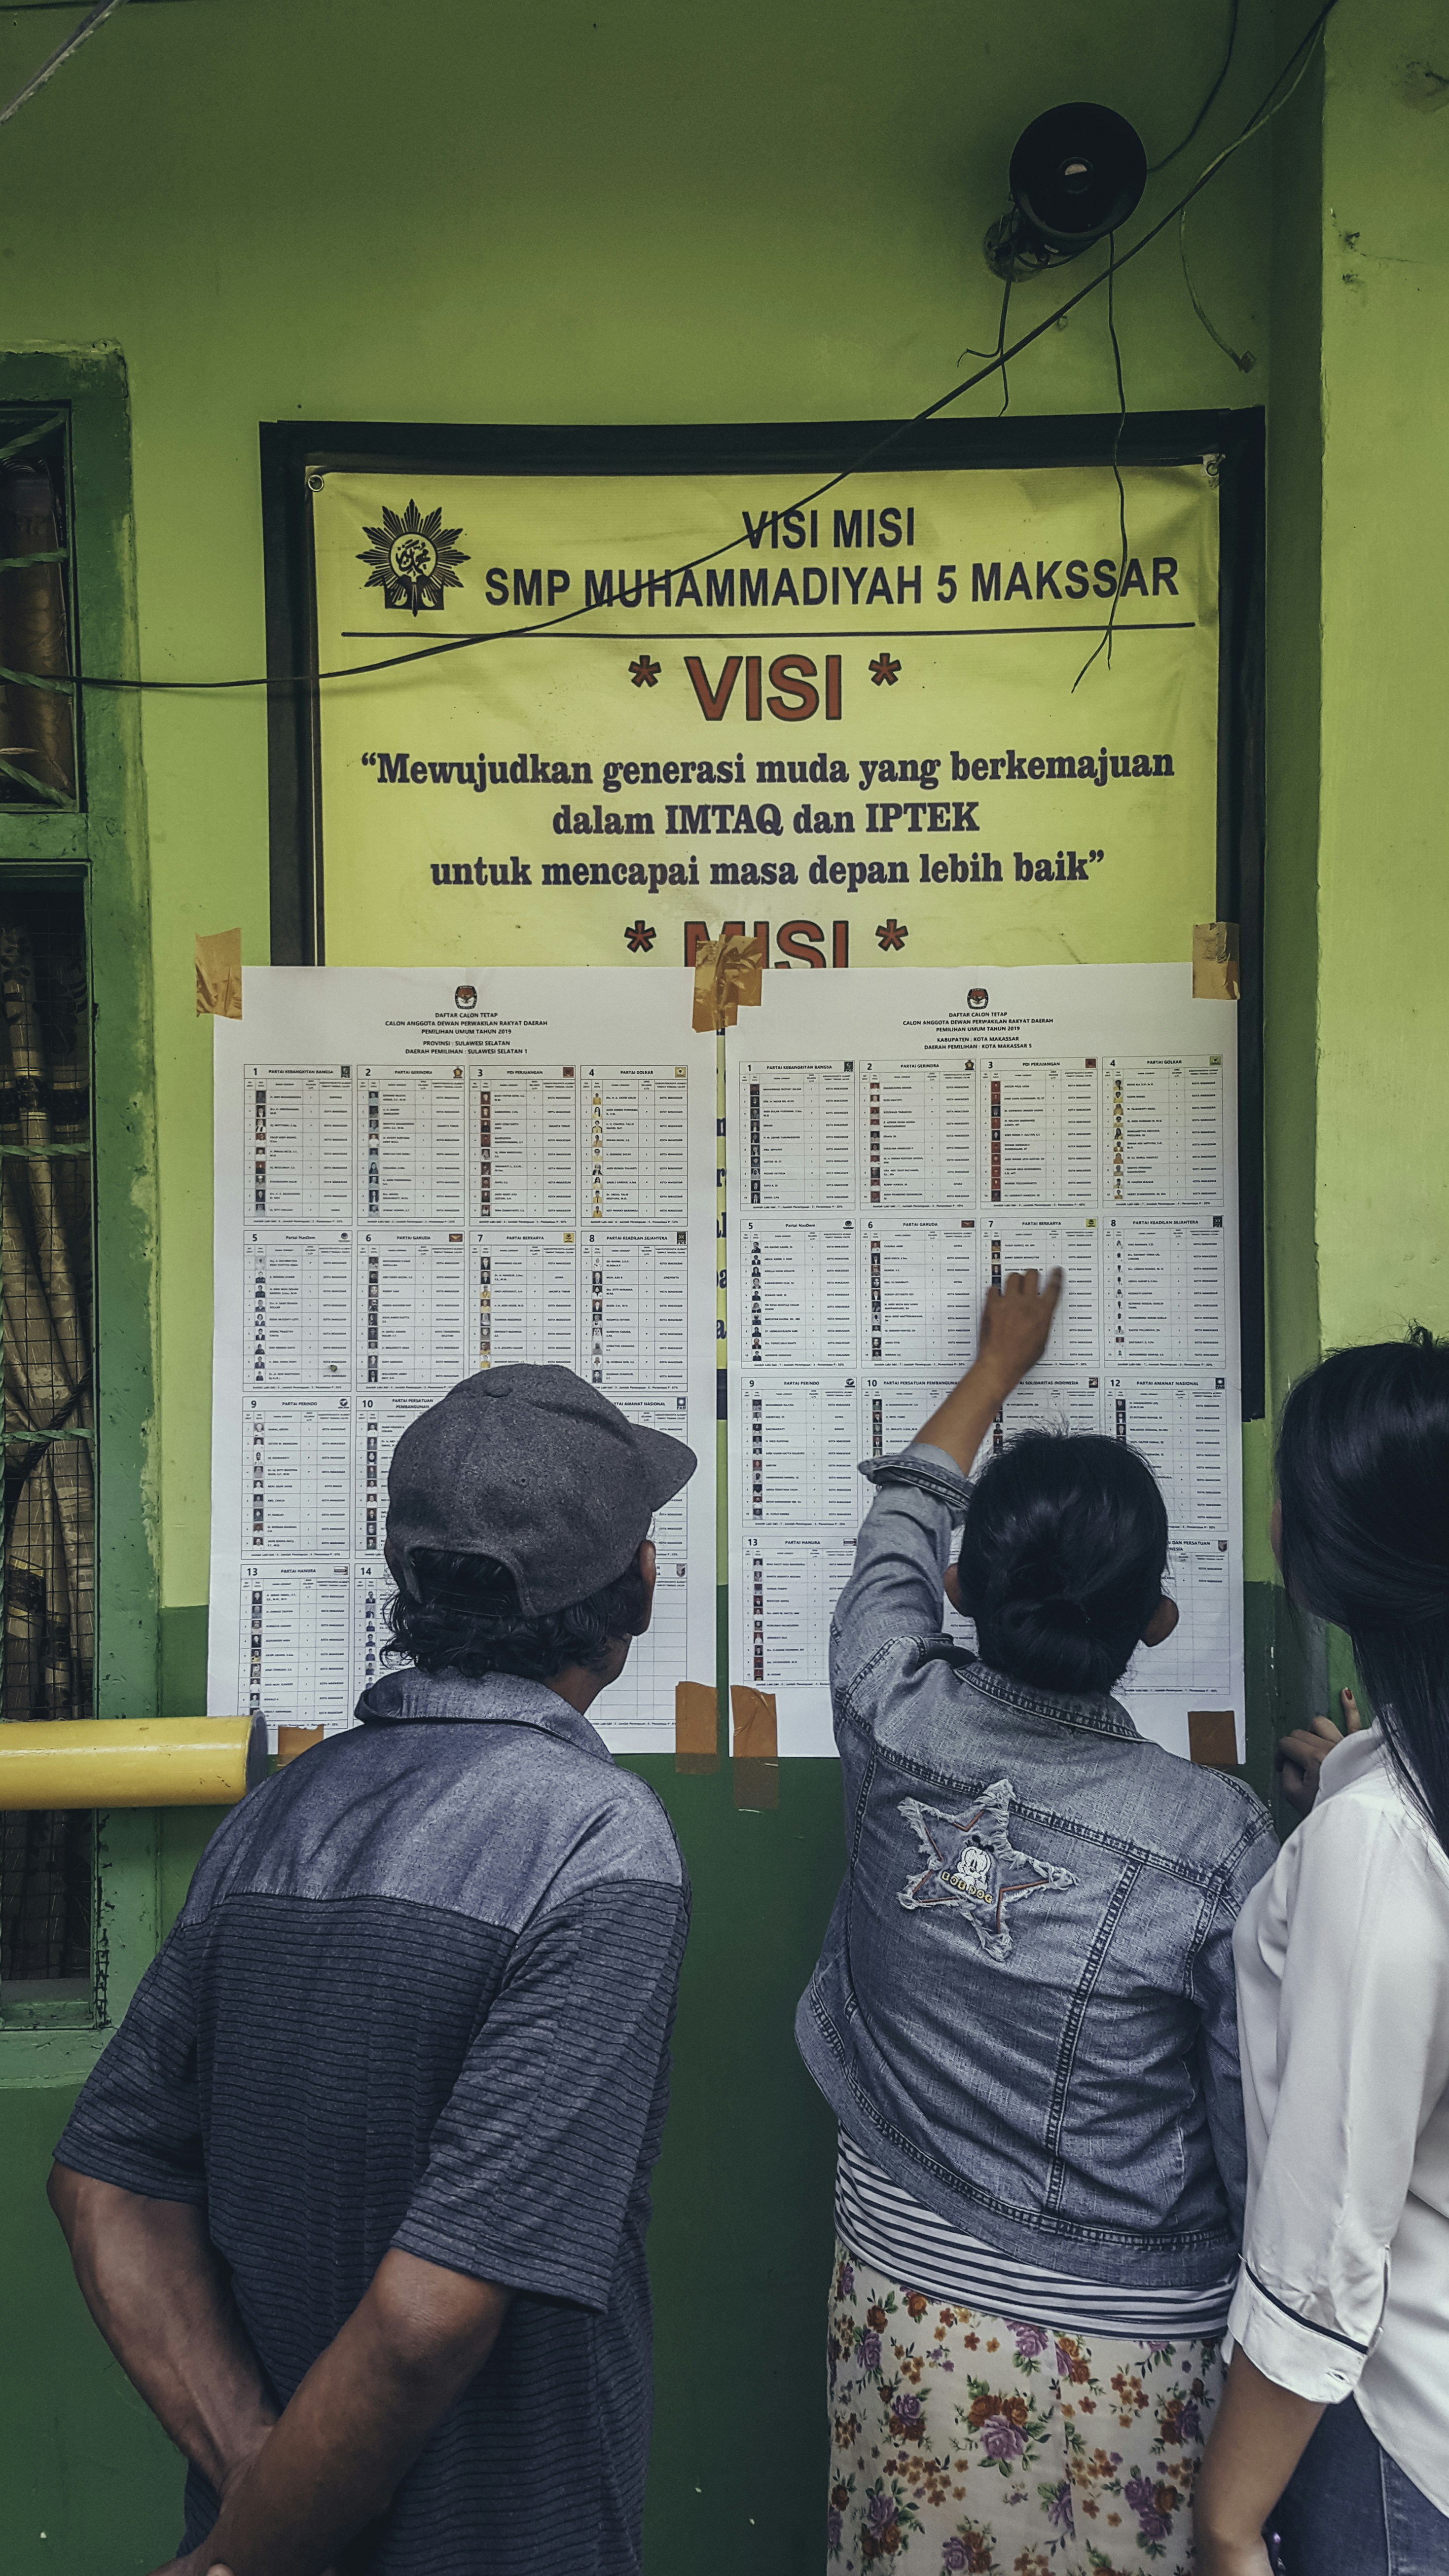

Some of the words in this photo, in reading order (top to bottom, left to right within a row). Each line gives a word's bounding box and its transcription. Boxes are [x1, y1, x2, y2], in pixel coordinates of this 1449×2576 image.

[742, 509, 818, 549] VISI
[834, 507, 914, 547] MISI
[485, 567, 570, 606] SMP
[585, 565, 921, 607] MUHAMMADIYAH
[937, 565, 957, 603] 5
[972, 557, 1179, 602] MAKSSAR
[684, 654, 841, 722] VISI
[603, 753, 746, 793] generasi
[756, 753, 849, 783] muda
[859, 759, 941, 791] yang
[950, 747, 1175, 787] berkemajuan
[553, 804, 654, 834] dalam
[665, 803, 783, 836] IMTAQ
[794, 804, 855, 834] dan
[866, 801, 979, 832] IPTEK
[430, 856, 532, 885] untuk
[542, 855, 699, 894] mencapai
[710, 863, 798, 885] masa
[809, 855, 909, 893] depan
[919, 852, 1003, 883] lebih
[988, 1061, 993, 1069] 3
[365, 1068, 371, 1077] 2
[477, 1069, 483, 1077] 3
[252, 1234, 257, 1242] 5
[477, 1234, 483, 1242] 7
[362, 1400, 373, 1408] 10
[247, 1567, 258, 1576] 13
[361, 1567, 372, 1575] 14
[941, 1871, 967, 1890] BOB
[968, 1885, 993, 1904] DOG
